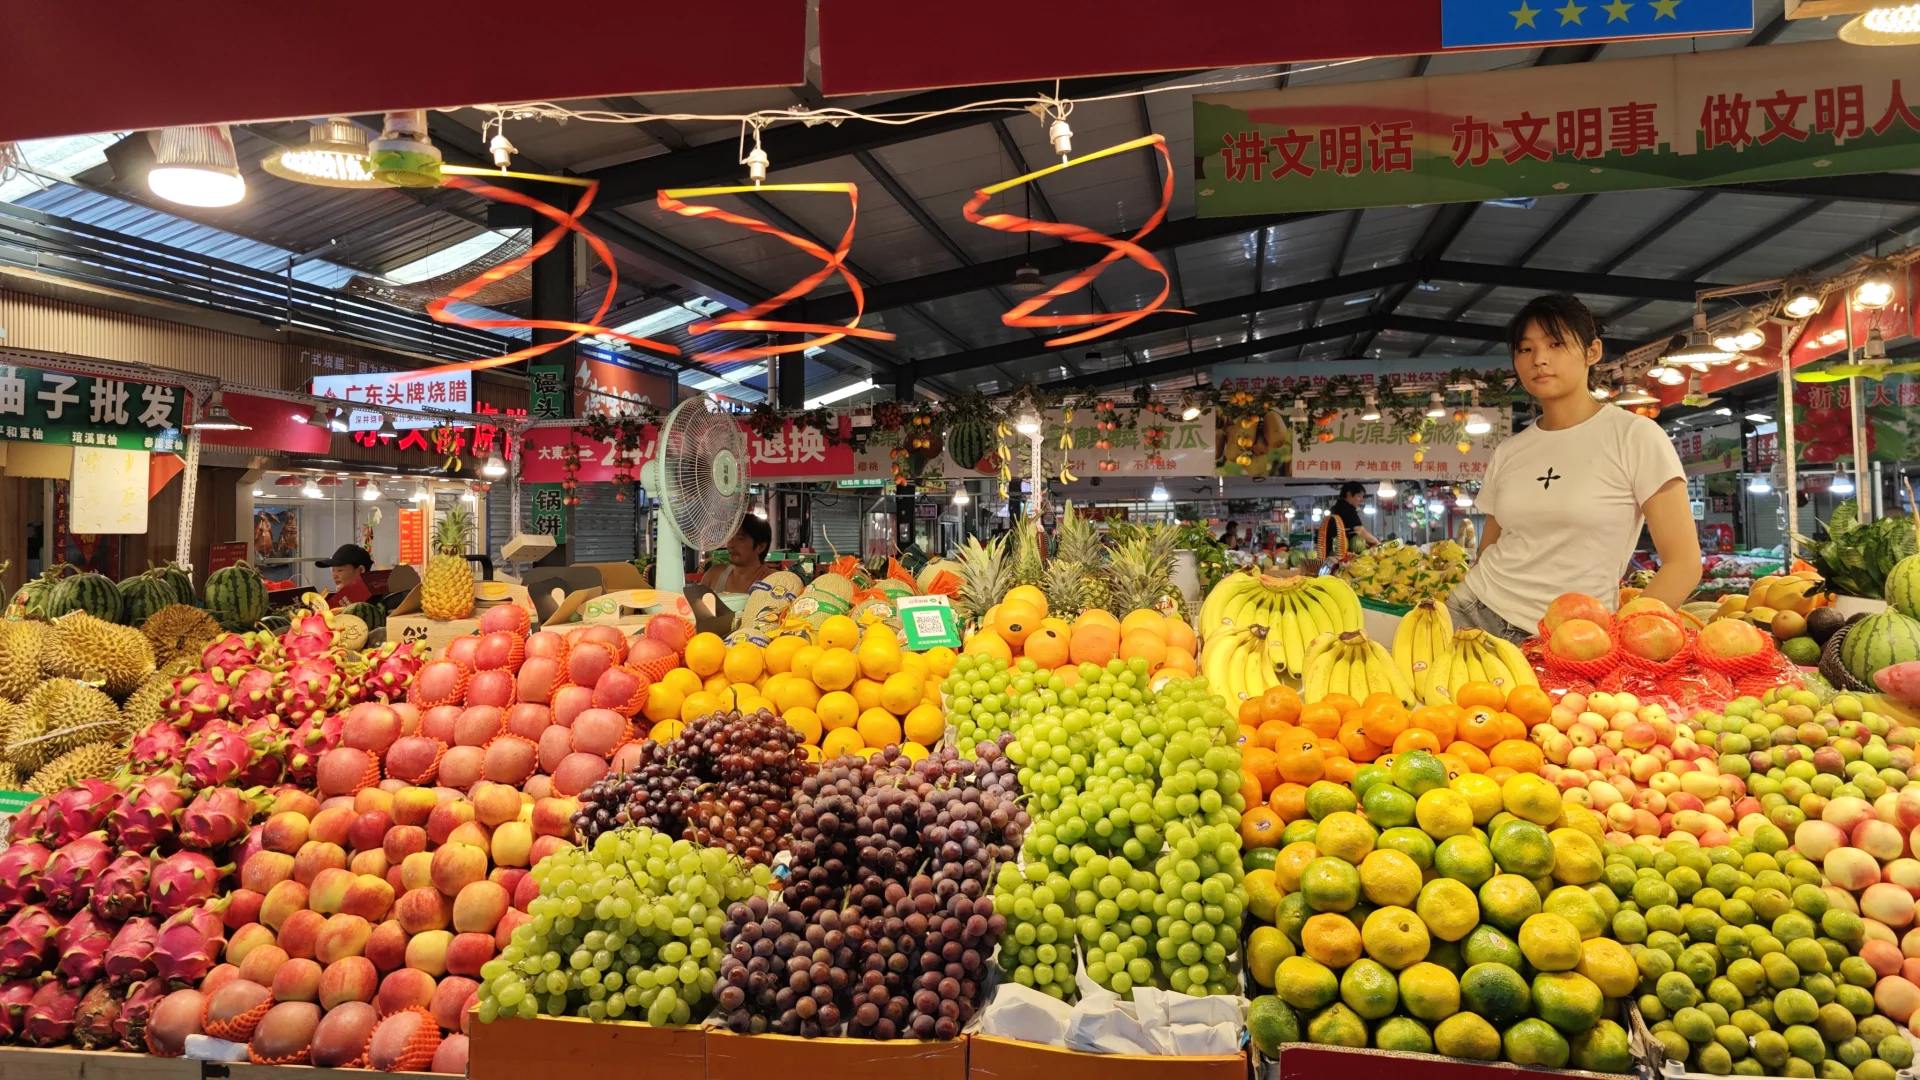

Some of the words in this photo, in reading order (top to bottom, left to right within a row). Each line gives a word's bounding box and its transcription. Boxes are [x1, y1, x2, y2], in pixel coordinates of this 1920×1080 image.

[1221, 119, 1414, 183] 讲文明话
[1451, 102, 1659, 170] 办文明事
[1700, 79, 1920, 150] 做文明人
[345, 379, 468, 405] 广东头牌烧腊
[534, 371, 560, 418] 馒头
[854, 461, 879, 472] 樱桃
[1296, 460, 1341, 472] 自产自销
[1354, 460, 1402, 472] 产地直供
[1413, 460, 1448, 472] 可采摘
[536, 489, 562, 536] 锅饼
